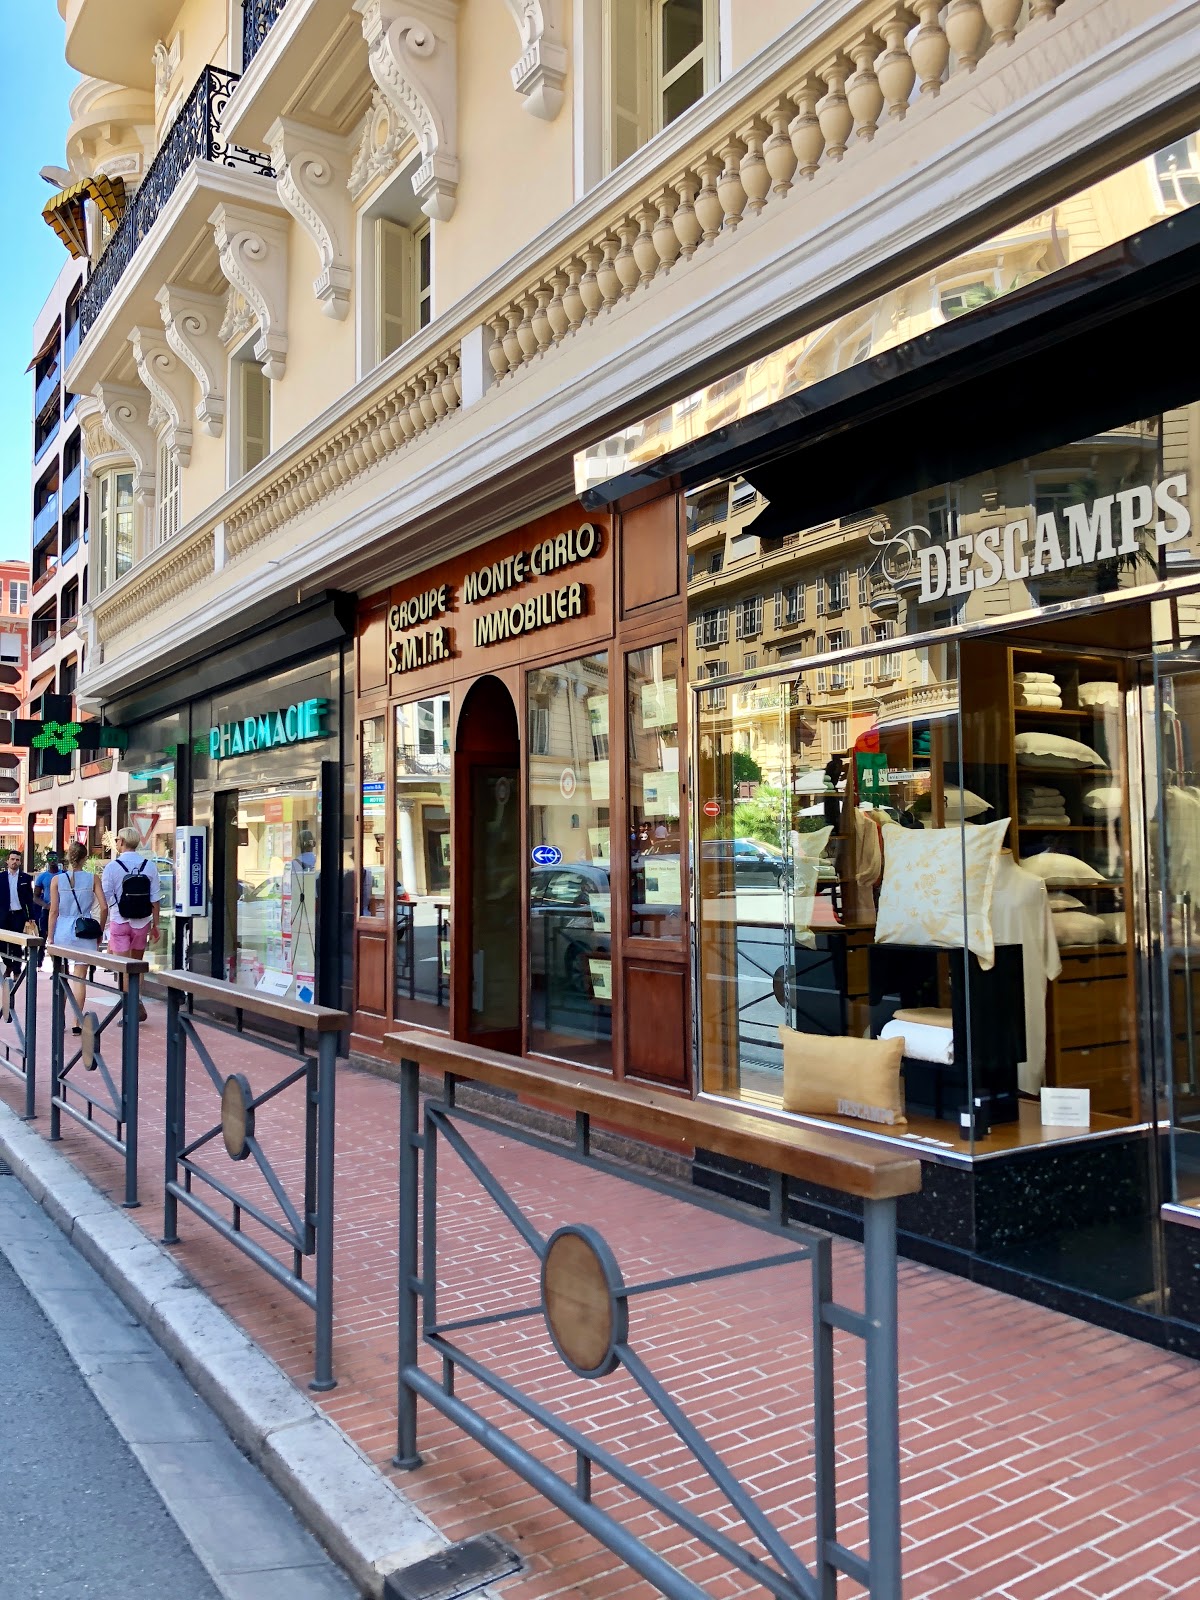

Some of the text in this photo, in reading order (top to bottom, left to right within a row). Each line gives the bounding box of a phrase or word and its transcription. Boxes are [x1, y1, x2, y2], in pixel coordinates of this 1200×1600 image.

[388, 522, 596, 631] GROUPE MONTE-CARLO
[917, 474, 1191, 604] DESCAMPS
[388, 581, 582, 674] S.M.I.R. IMMOBILIER
[209, 697, 321, 760] PHARMACIE
